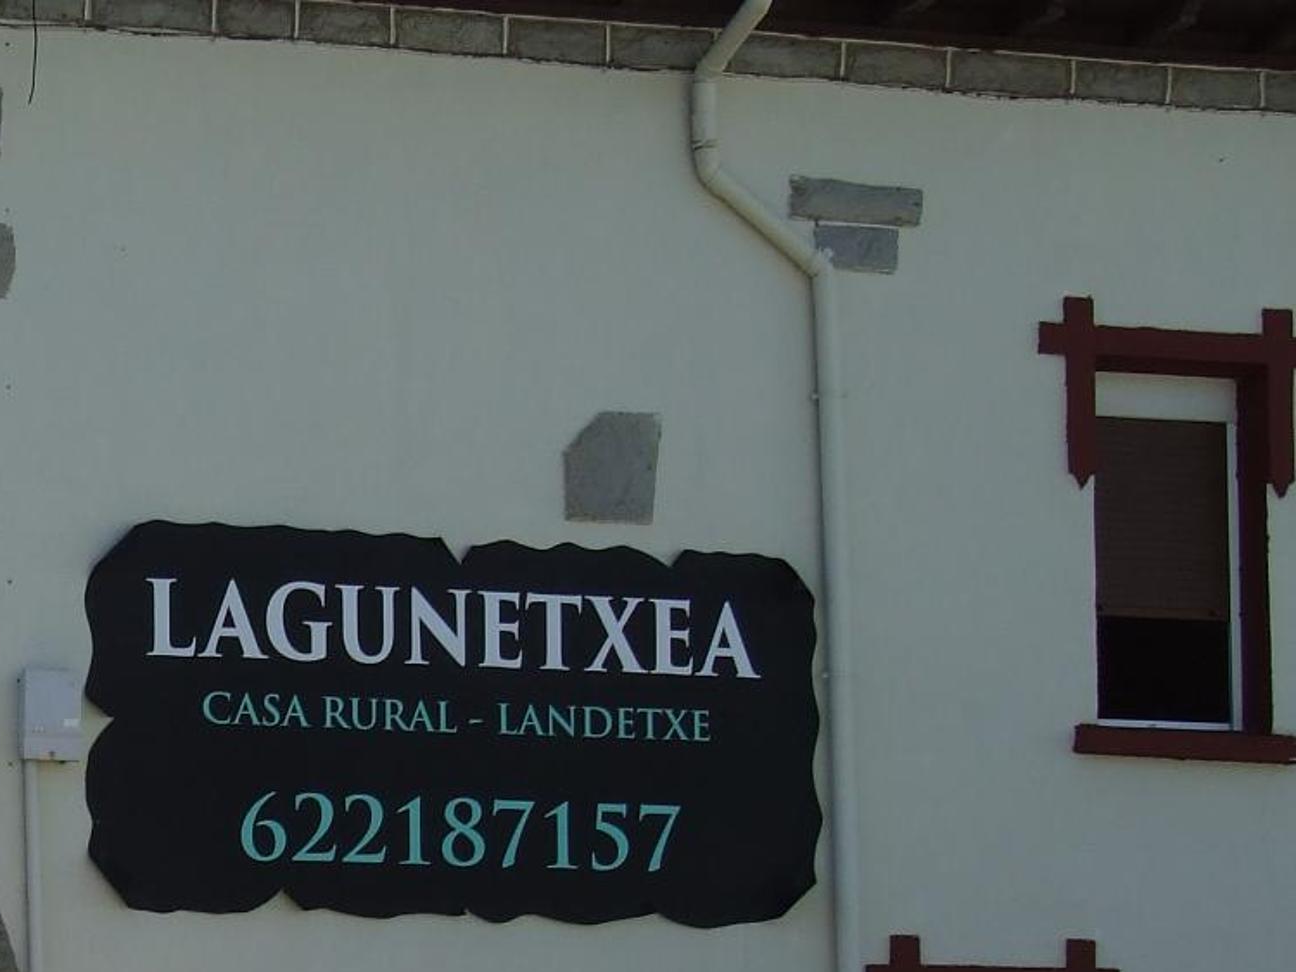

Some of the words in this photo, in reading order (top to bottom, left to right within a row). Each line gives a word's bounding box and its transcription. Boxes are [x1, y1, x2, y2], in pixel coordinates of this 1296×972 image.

[145, 577, 762, 680] LAGUNETXEA
[202, 691, 309, 728] CASA
[322, 696, 457, 734] RURAL
[499, 702, 711, 742] LANDETXE
[240, 790, 682, 873] 622187157
